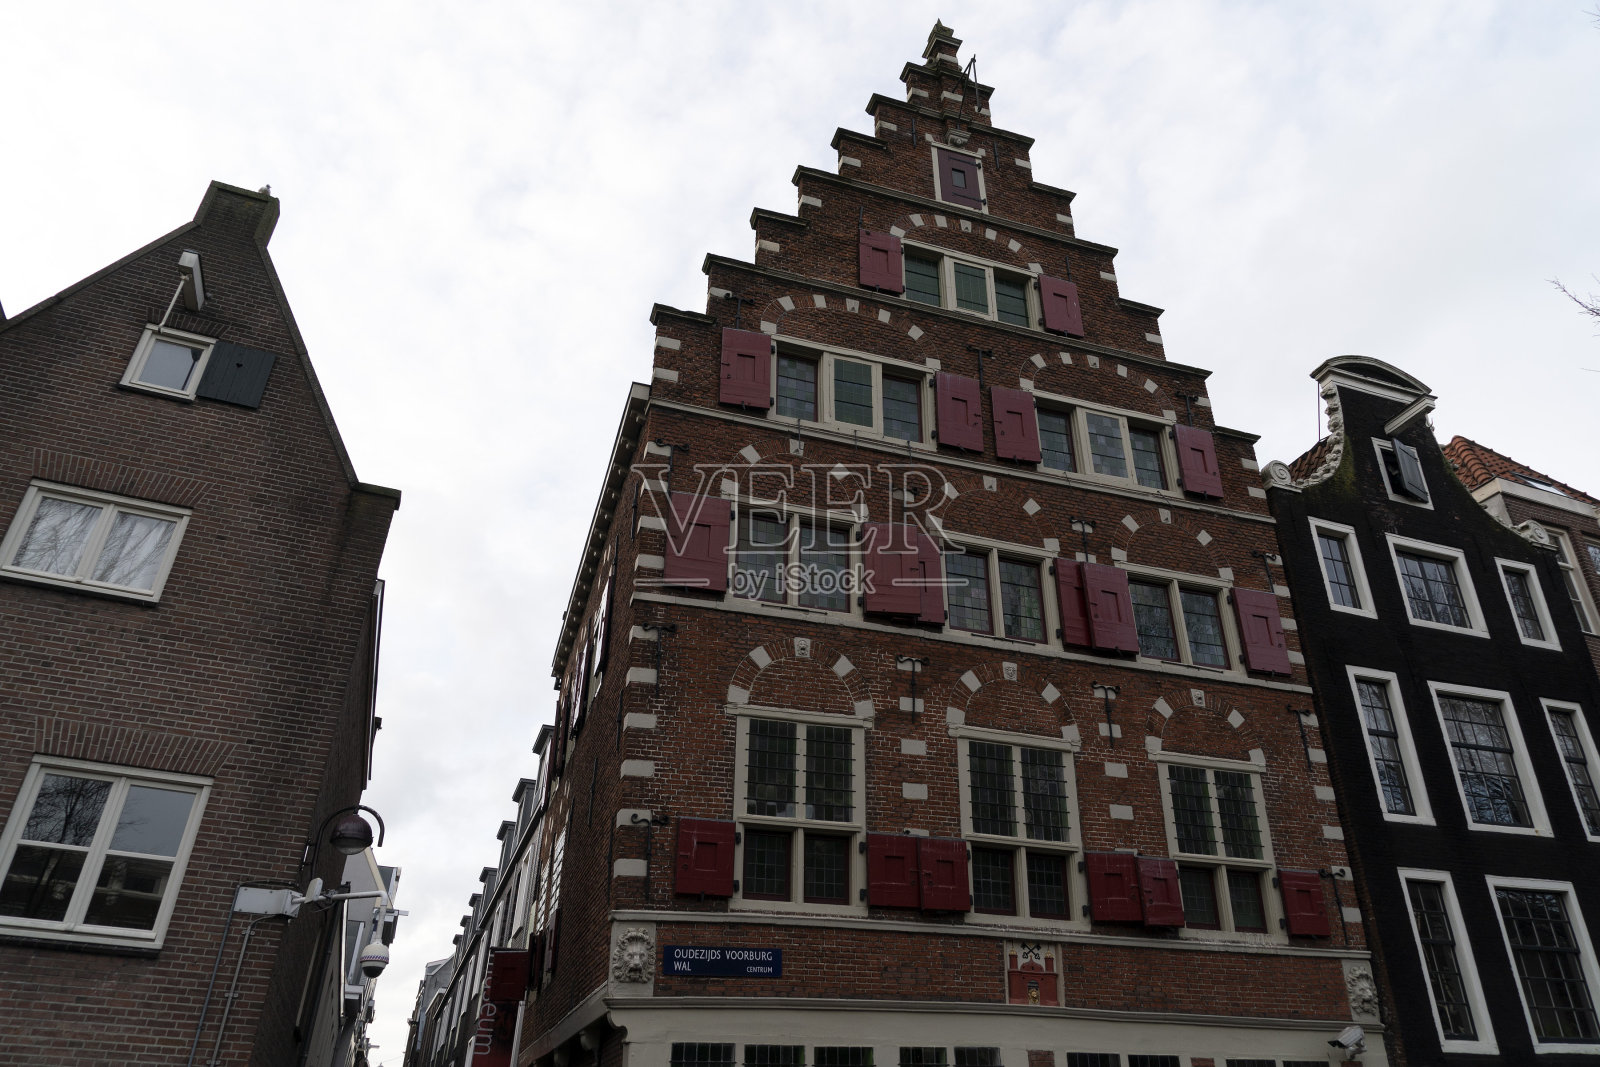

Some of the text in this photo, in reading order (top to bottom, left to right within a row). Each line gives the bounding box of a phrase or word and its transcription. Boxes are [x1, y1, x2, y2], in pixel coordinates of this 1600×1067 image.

[674, 948, 773, 962] OUDEZIJDS VOORBURG
[673, 961, 692, 972] WAL
[746, 965, 773, 974] CENTRUM
